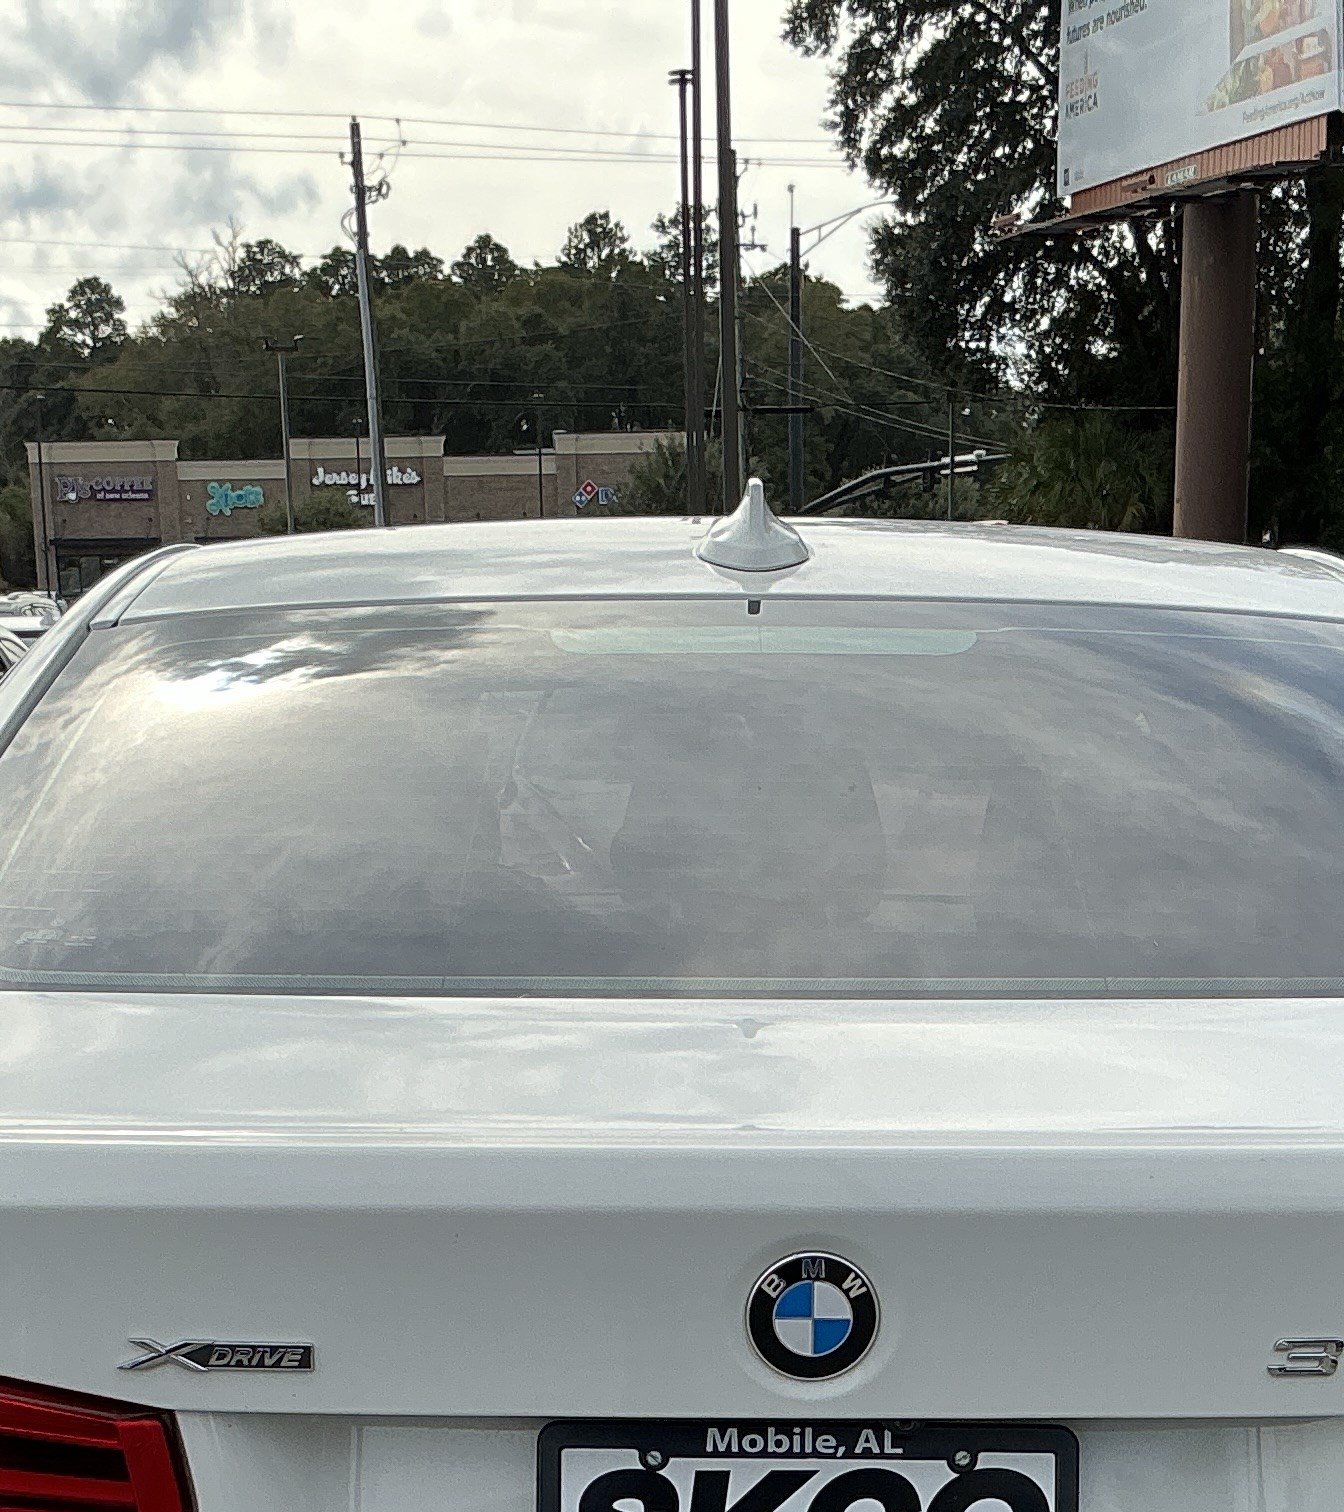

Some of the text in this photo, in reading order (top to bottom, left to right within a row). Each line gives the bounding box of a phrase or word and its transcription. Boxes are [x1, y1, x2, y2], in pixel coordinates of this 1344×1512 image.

[761, 1259, 867, 1299] BMW
[706, 1427, 903, 1457] Mobile, AL
